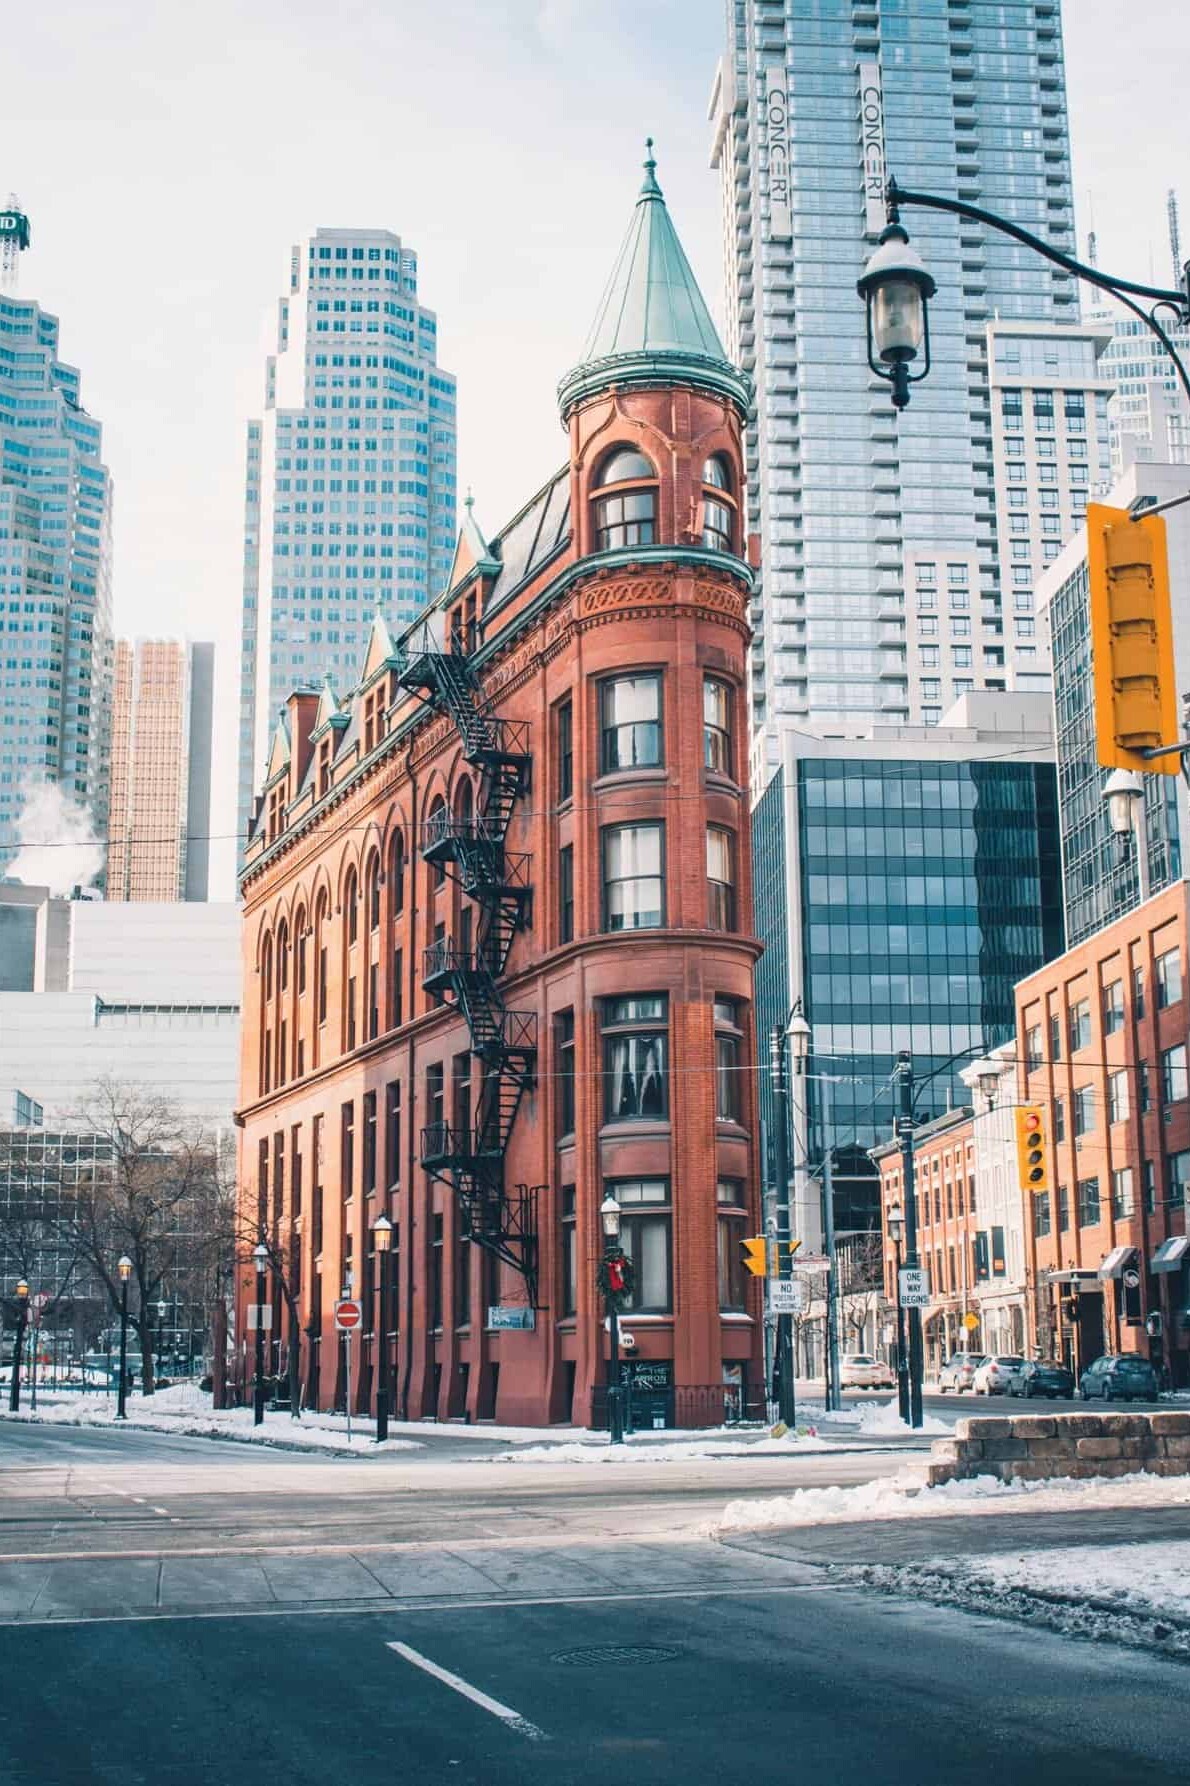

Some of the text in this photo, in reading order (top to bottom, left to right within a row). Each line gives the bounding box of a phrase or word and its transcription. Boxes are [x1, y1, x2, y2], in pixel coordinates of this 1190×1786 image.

[769, 89, 787, 207] CONCERT
[863, 87, 883, 203] CONCERT
[906, 1272, 922, 1281] ONE
[780, 1283, 792, 1294] NO
[907, 1284, 921, 1292] WAY
[901, 1295, 928, 1304] BEGINS
